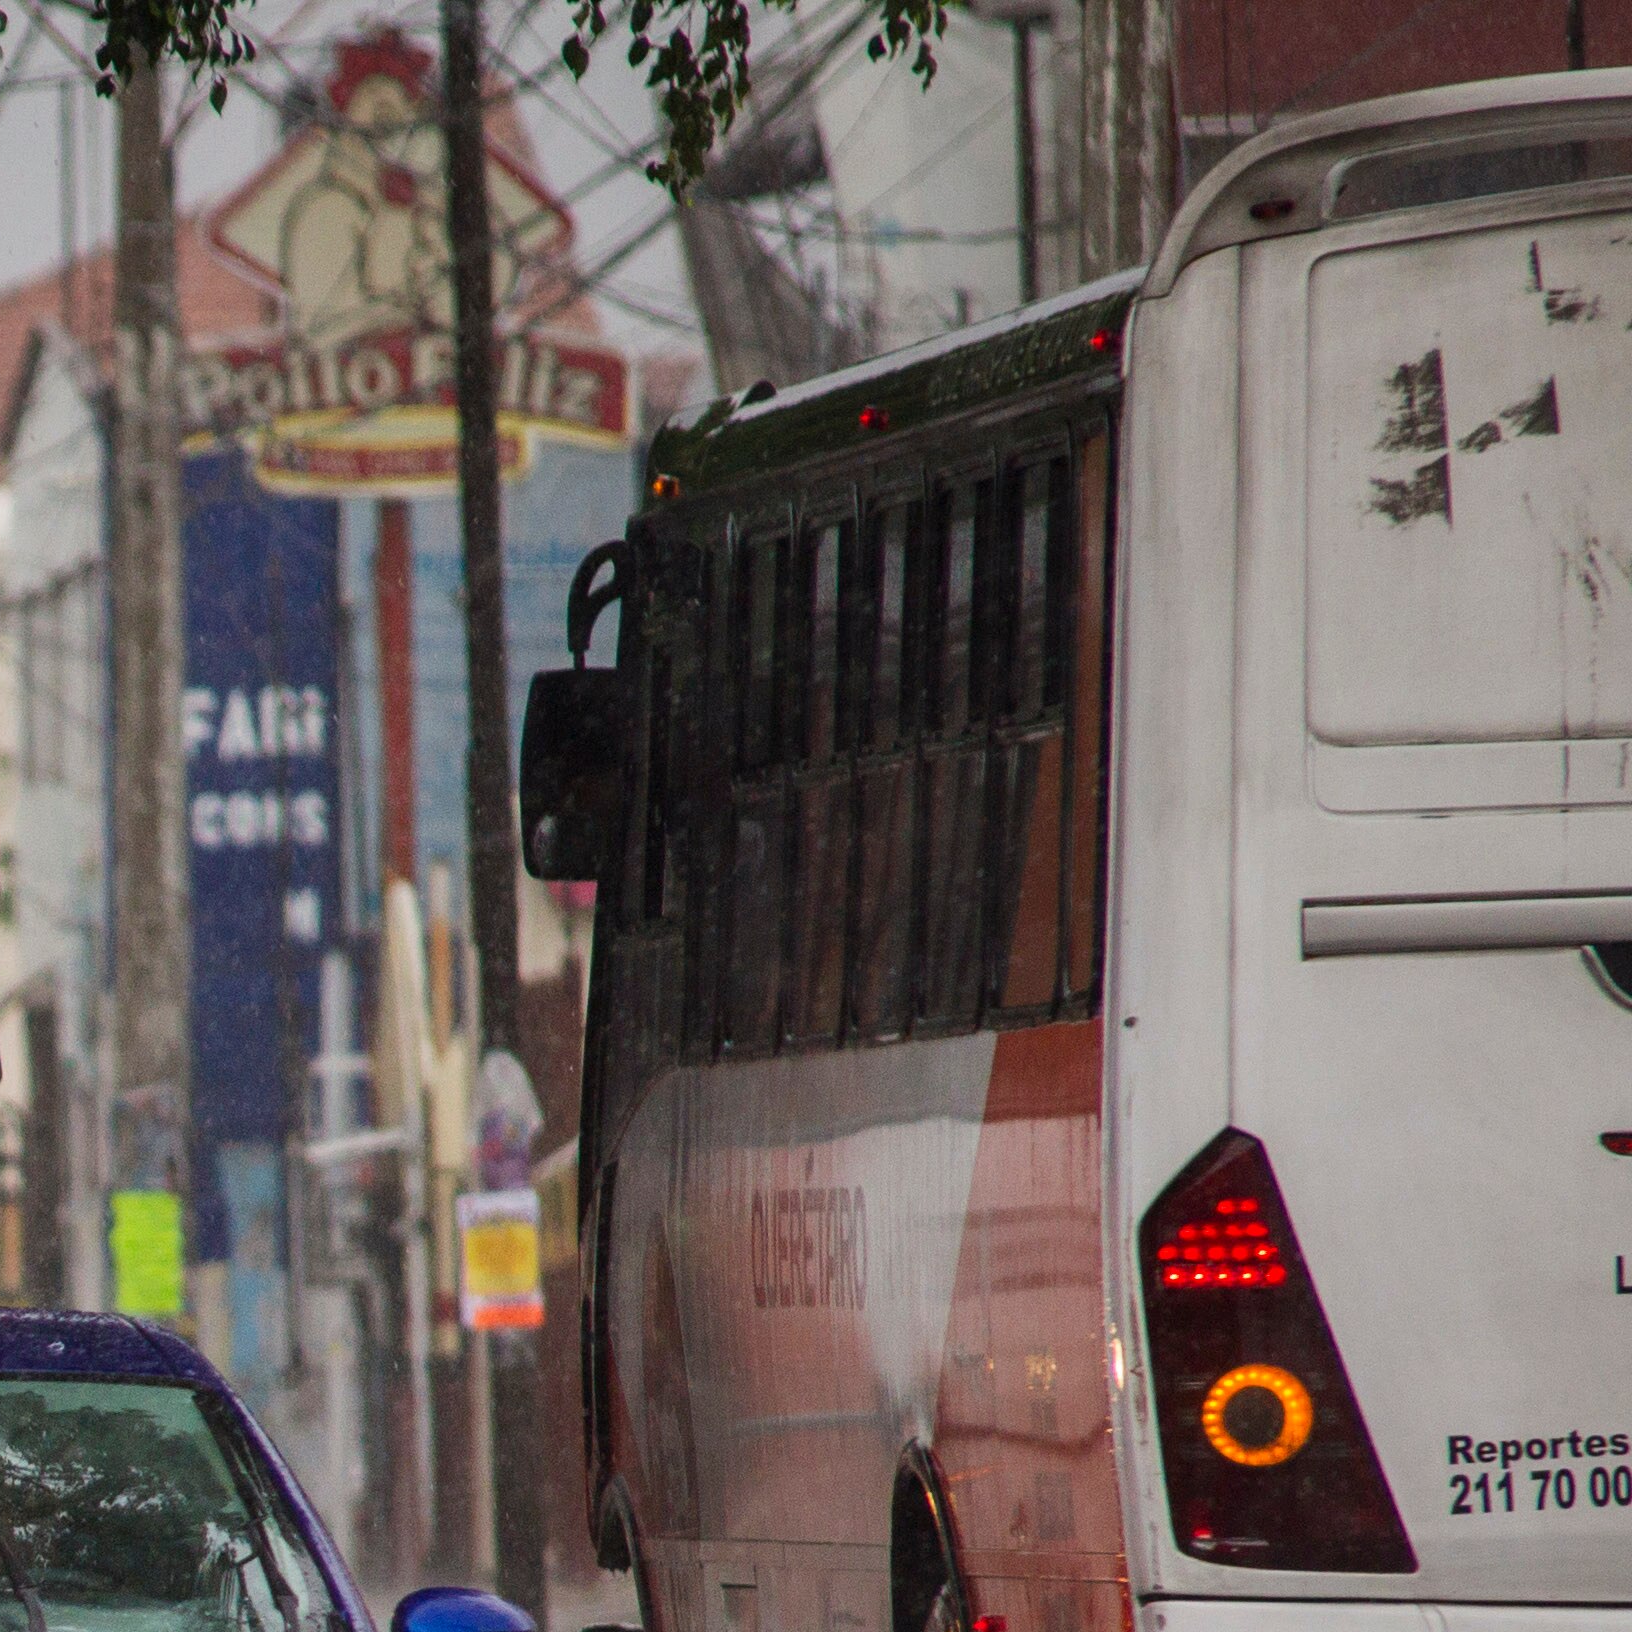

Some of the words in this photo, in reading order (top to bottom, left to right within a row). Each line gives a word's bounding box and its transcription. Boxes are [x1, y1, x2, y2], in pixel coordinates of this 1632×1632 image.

[181, 344, 400, 424] Pollo
[411, 332, 601, 424] Fliz
[1448, 1430, 1630, 1470] Reportes
[1449, 1471, 1515, 1515] 211
[1529, 1467, 1576, 1510] 70
[1588, 1465, 1632, 1507] 00
